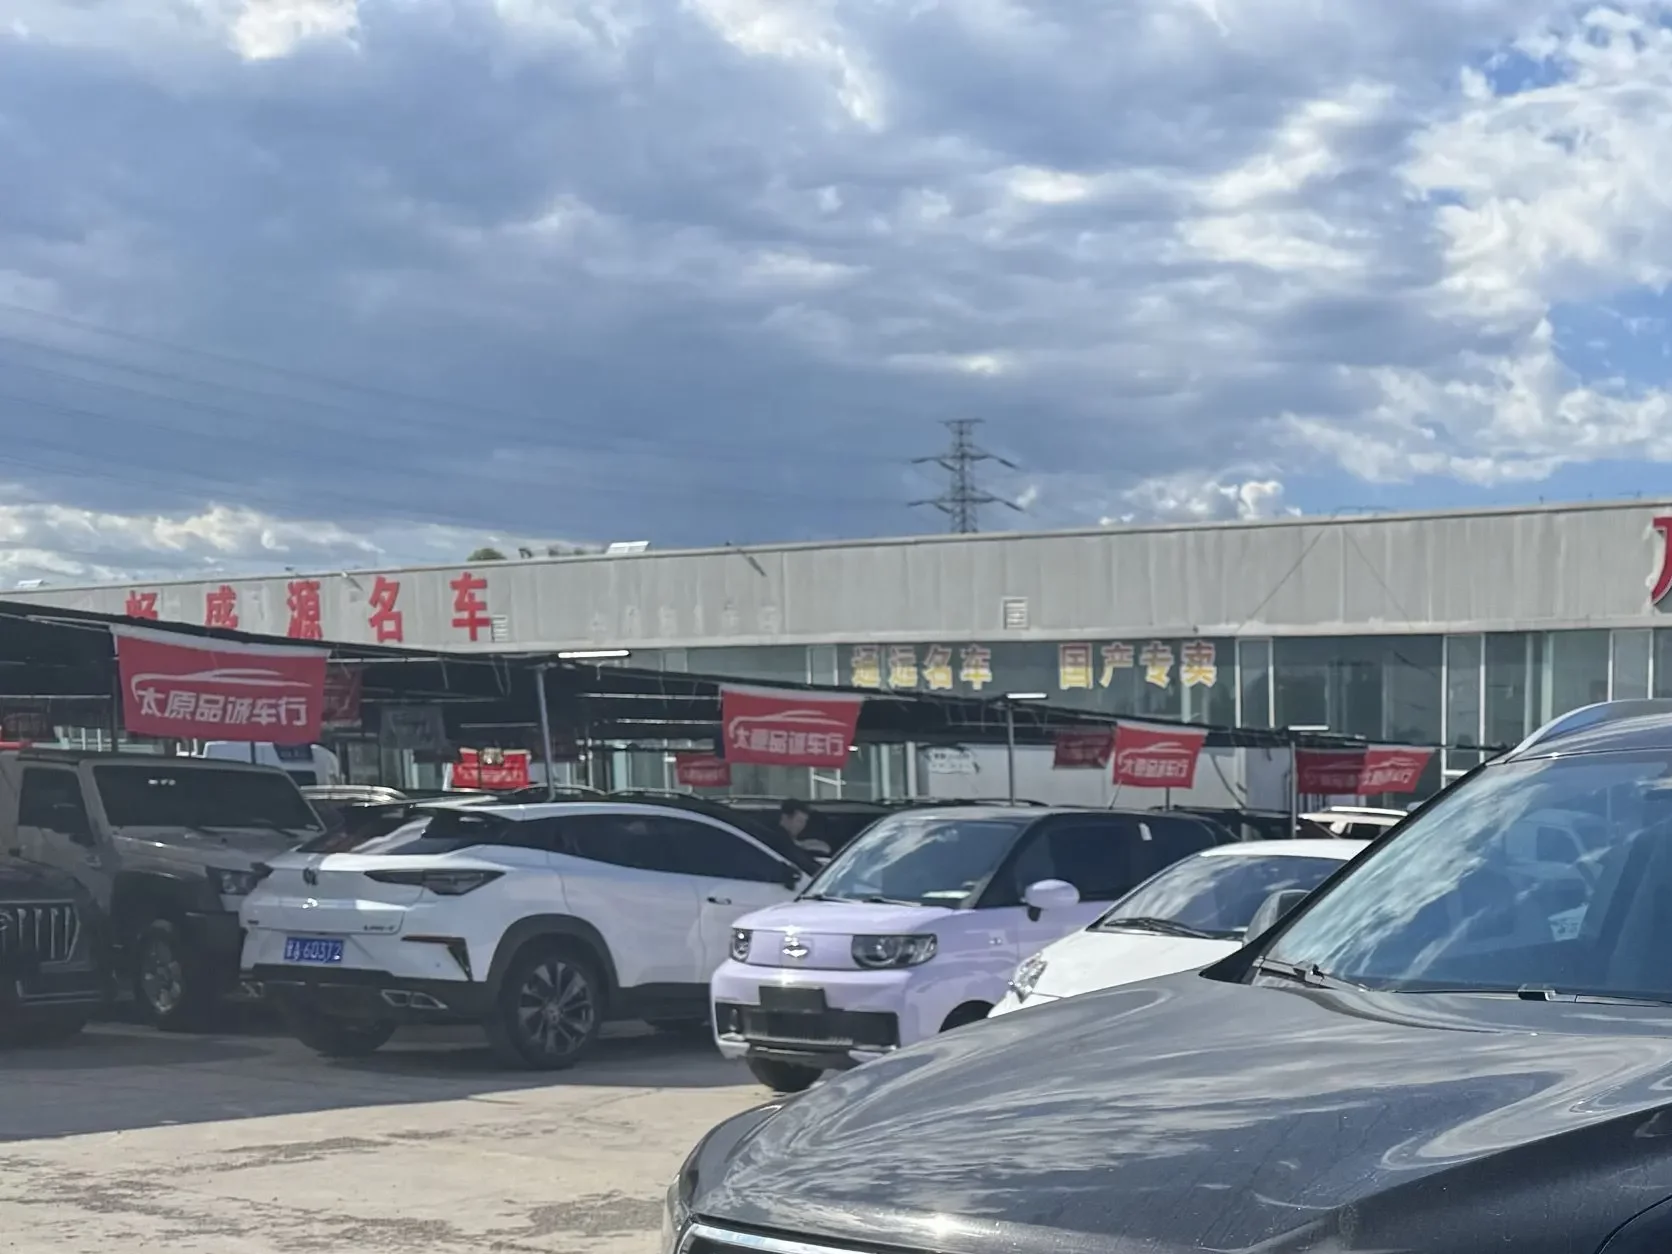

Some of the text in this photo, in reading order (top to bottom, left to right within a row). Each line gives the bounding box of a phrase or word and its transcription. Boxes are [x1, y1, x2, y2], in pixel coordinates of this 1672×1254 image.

[1058, 640, 1218, 690] 国产专卖
[135, 686, 309, 728] 太原品诚车行
